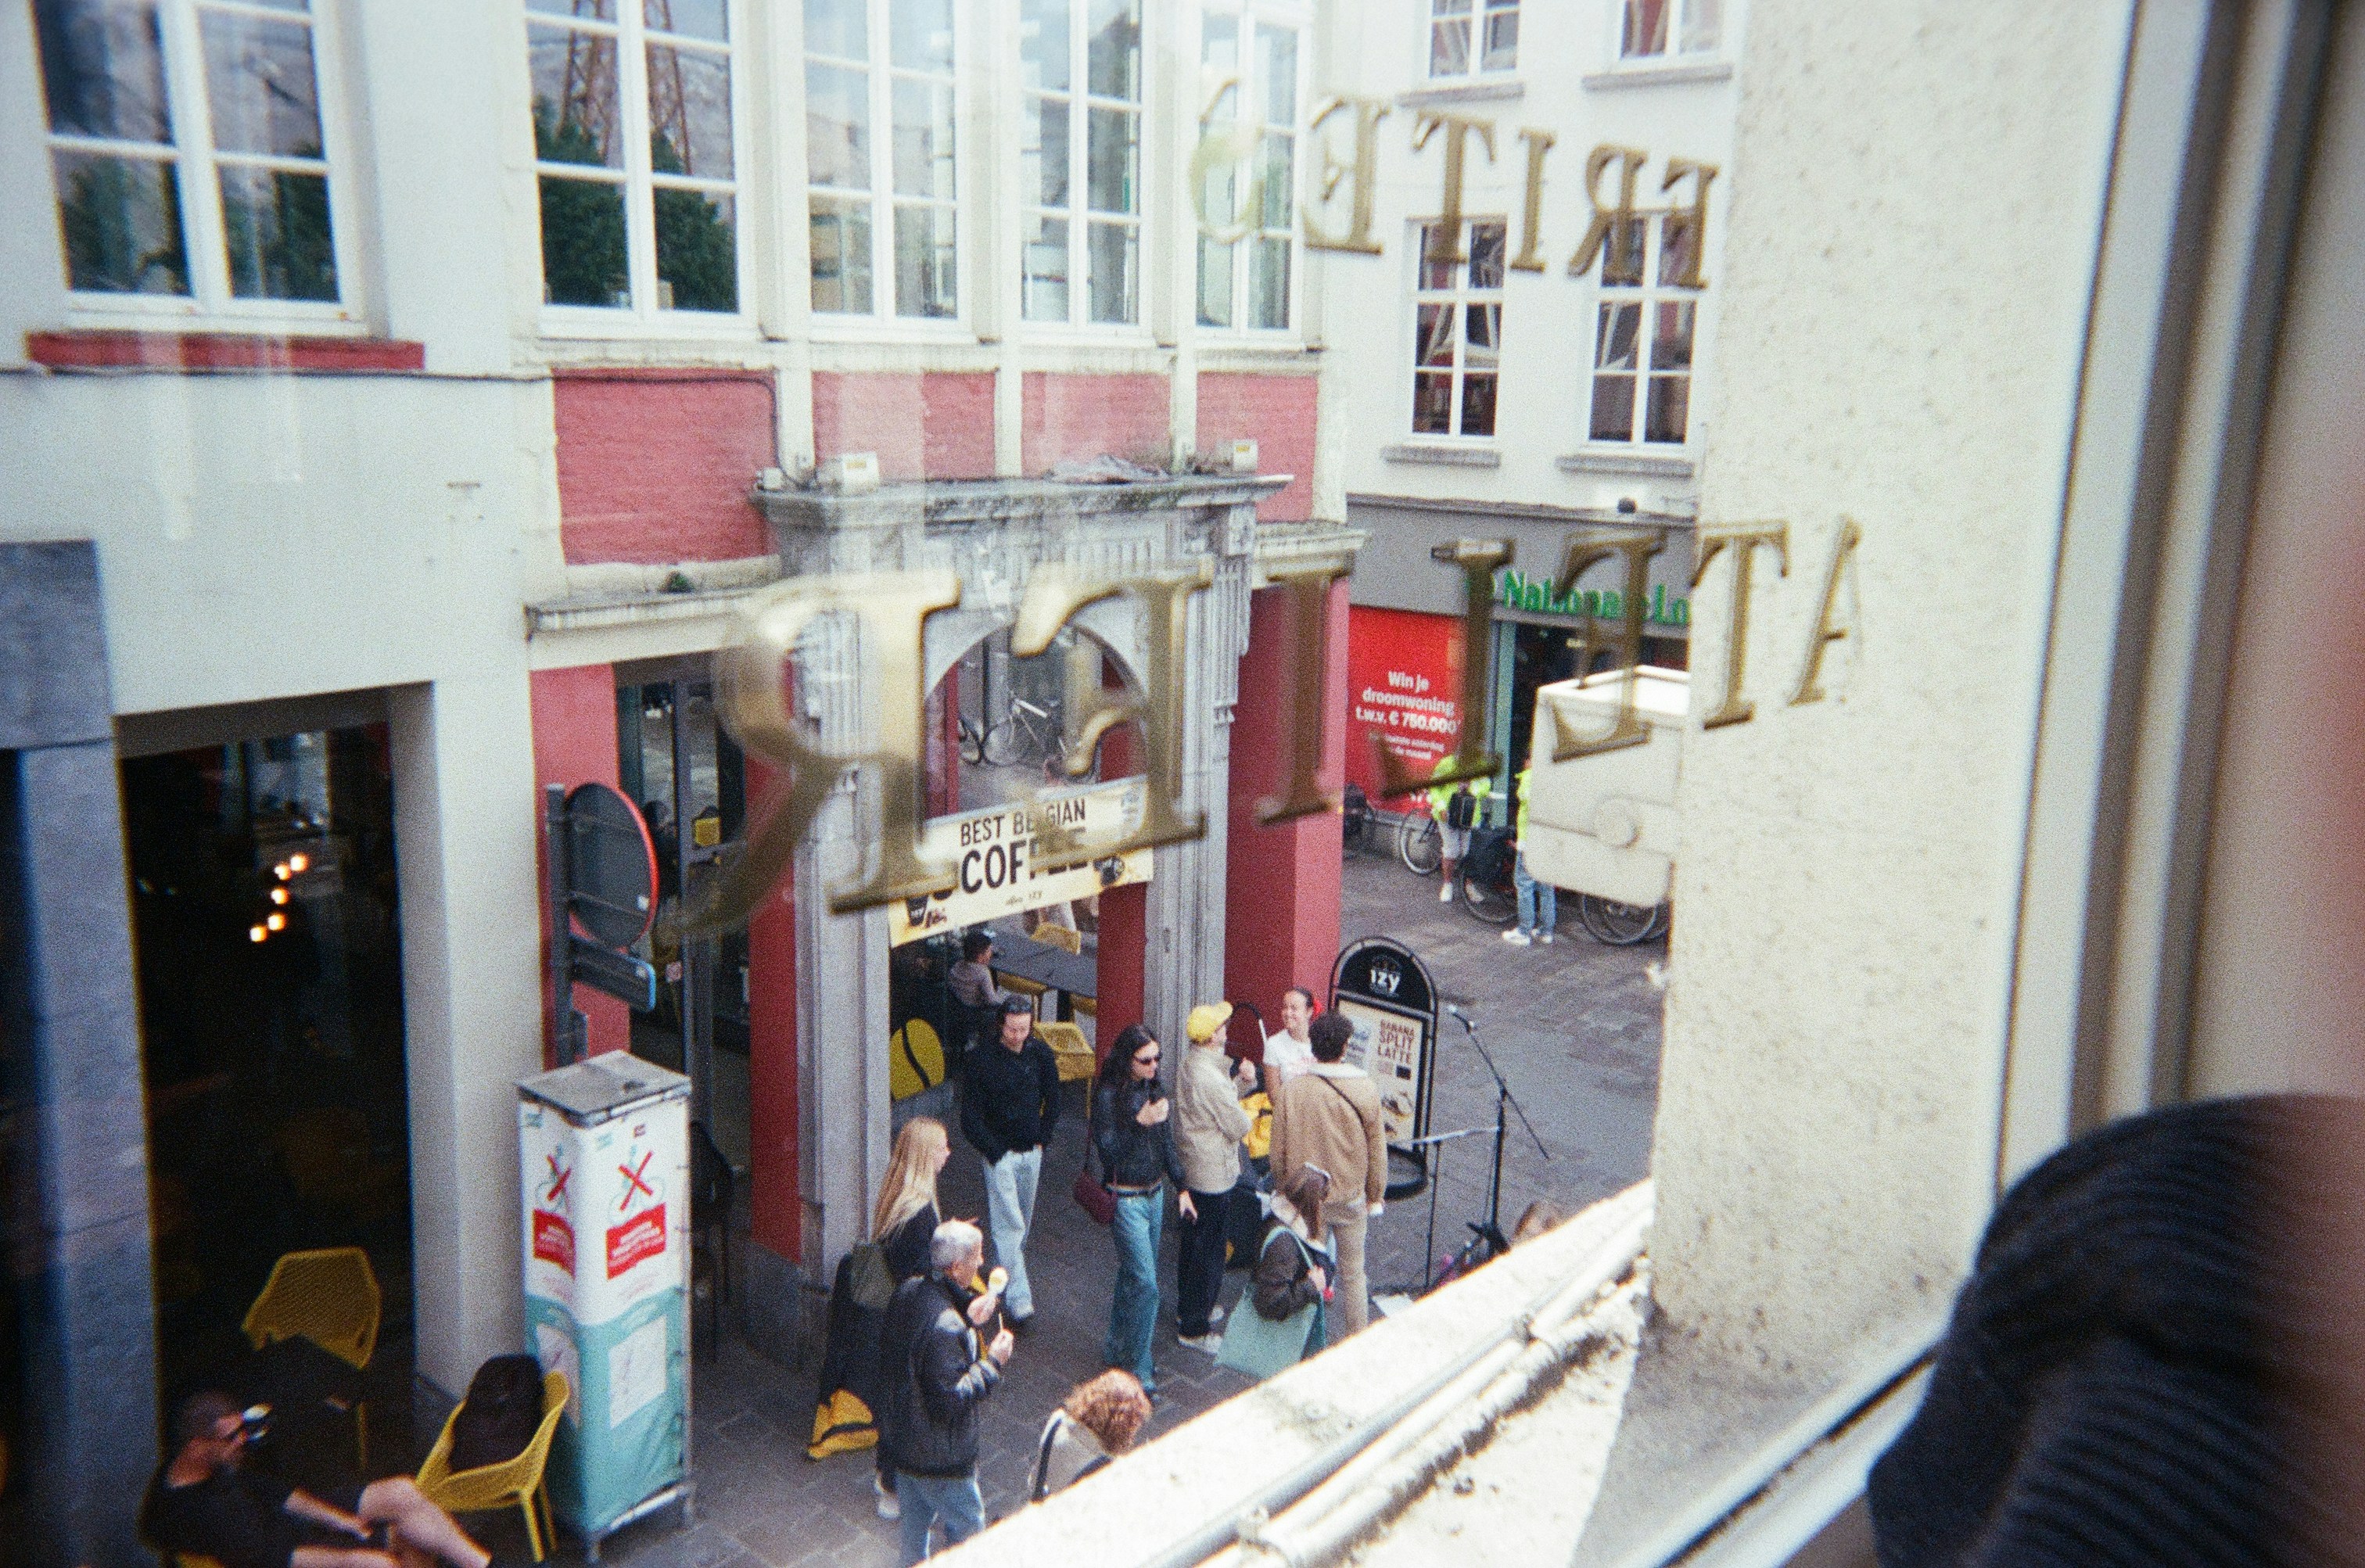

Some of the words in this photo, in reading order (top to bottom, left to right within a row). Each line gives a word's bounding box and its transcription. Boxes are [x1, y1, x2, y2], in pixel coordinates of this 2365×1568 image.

[1387, 671, 1414, 689] Win
[1415, 673, 1430, 694] je
[1362, 686, 1455, 718] droomwoning
[1355, 705, 1387, 725] t.w.v.
[960, 814, 1005, 847] BEST
[1013, 798, 1086, 836] BEGIAN
[1379, 1032, 1414, 1051] SPLIT
[1377, 1044, 1411, 1065] LATTE
